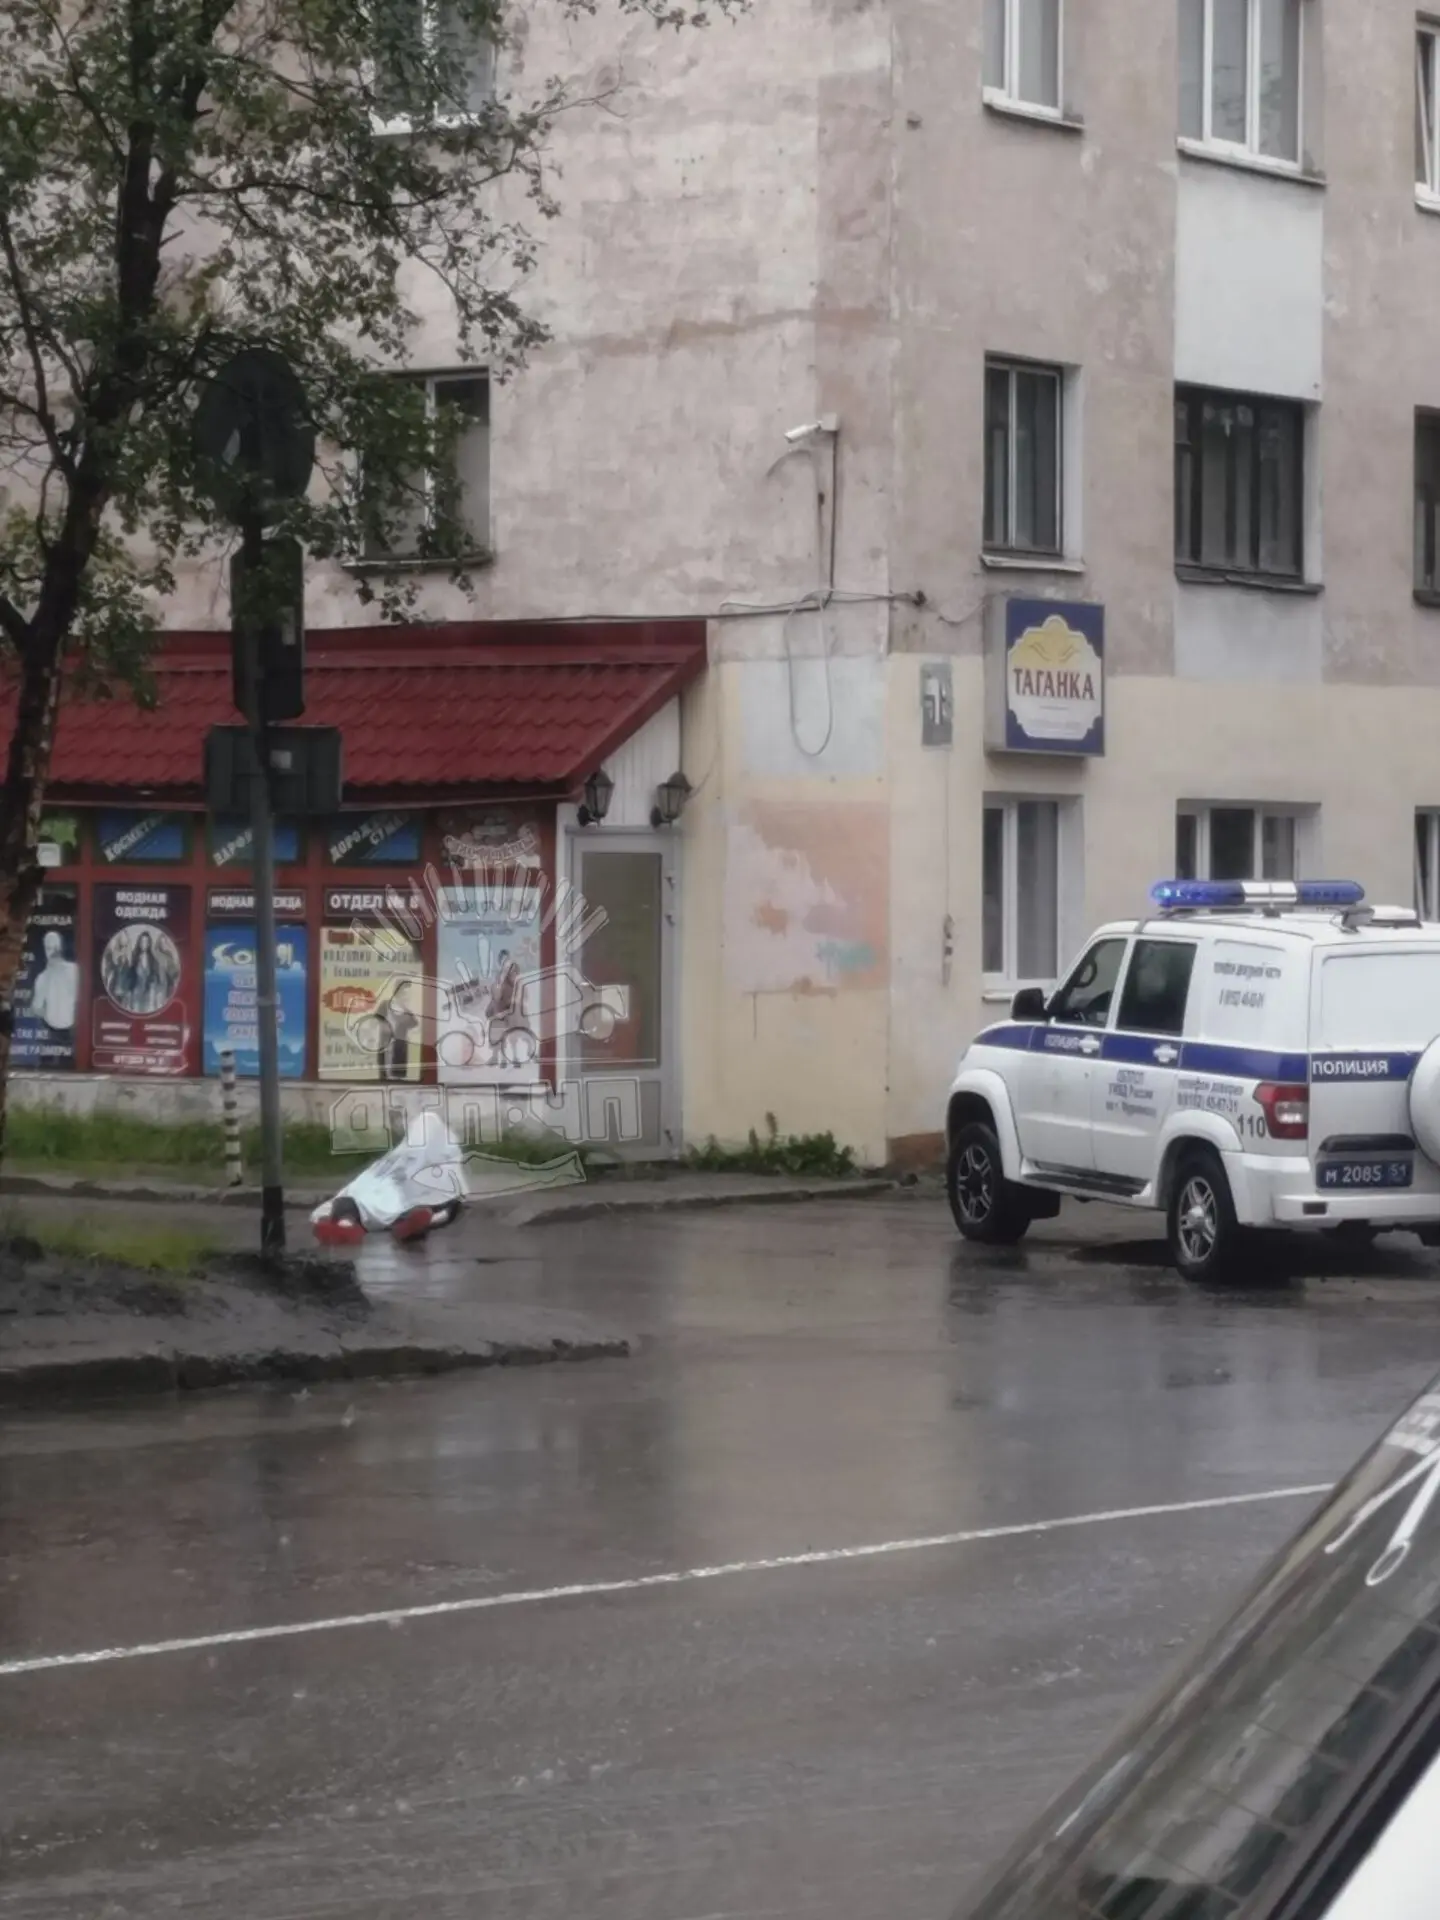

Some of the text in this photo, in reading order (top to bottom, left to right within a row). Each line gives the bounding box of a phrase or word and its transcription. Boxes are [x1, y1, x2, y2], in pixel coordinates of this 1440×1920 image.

[1013, 668, 1096, 701] ТАГАНКА
[116, 891, 167, 904] МОДНАЯ
[272, 896, 302, 909] ЕЖДА
[330, 895, 382, 911] ОТДЕЛ
[115, 906, 167, 920] ОДЕЖДА
[1312, 1060, 1389, 1077] ПОЛИЦИЯ
[1238, 1114, 1266, 1138] 110
[1342, 1165, 1382, 1183] 2085
[1389, 1164, 1407, 1176] 51
